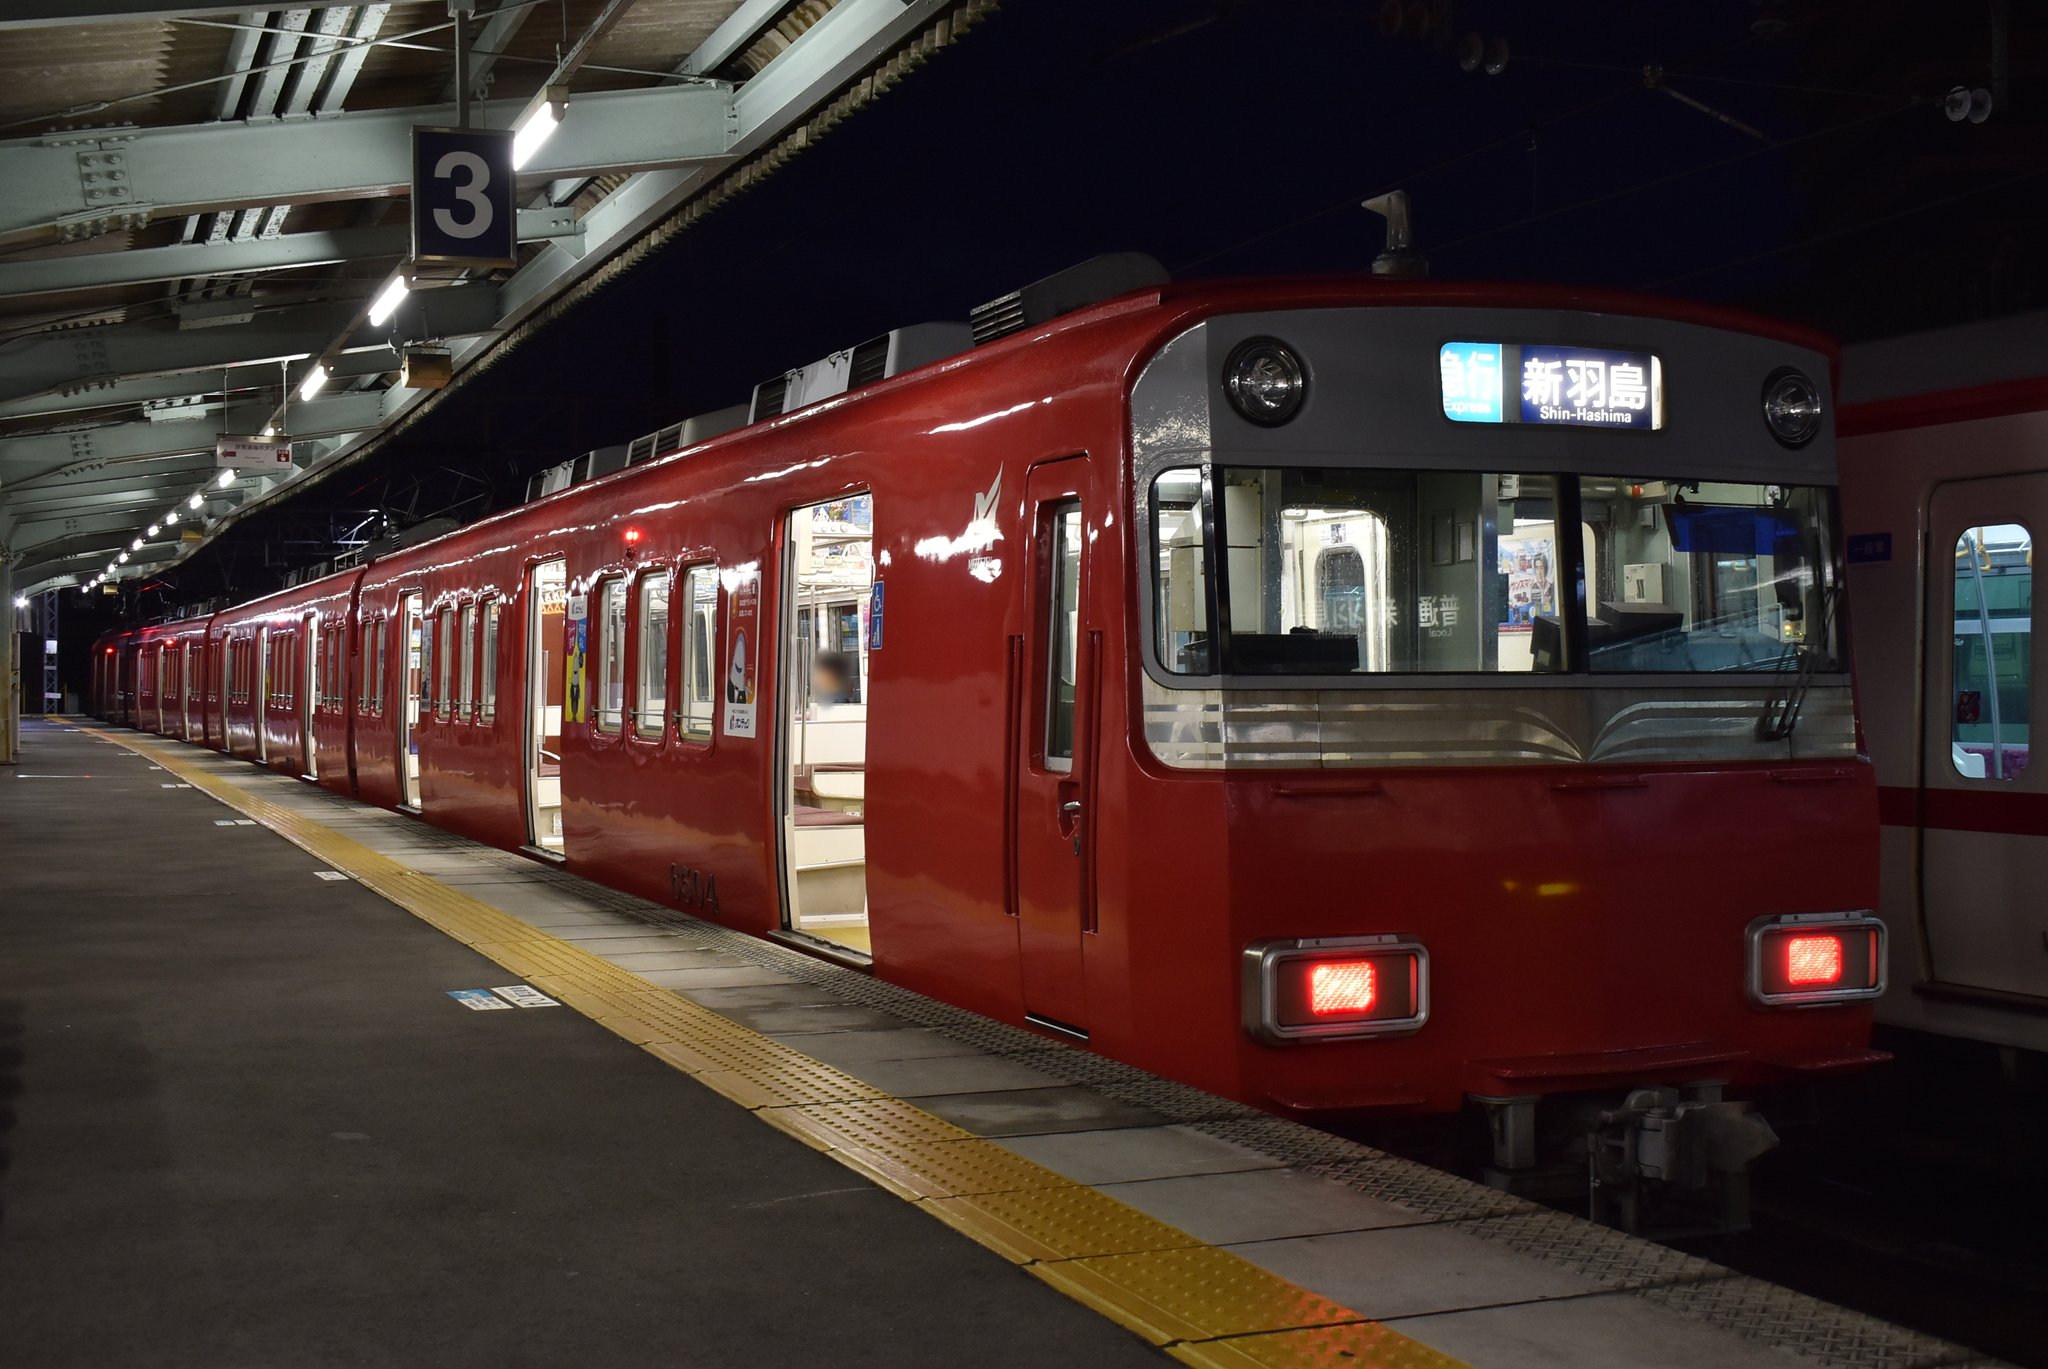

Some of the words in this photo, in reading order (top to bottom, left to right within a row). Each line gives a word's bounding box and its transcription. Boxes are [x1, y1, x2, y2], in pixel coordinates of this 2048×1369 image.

[432, 151, 494, 239] 3
[1441, 350, 1496, 400] 急行
[1522, 357, 1648, 411] 新羽島
[1539, 405, 1632, 424] Shin-Hashima
